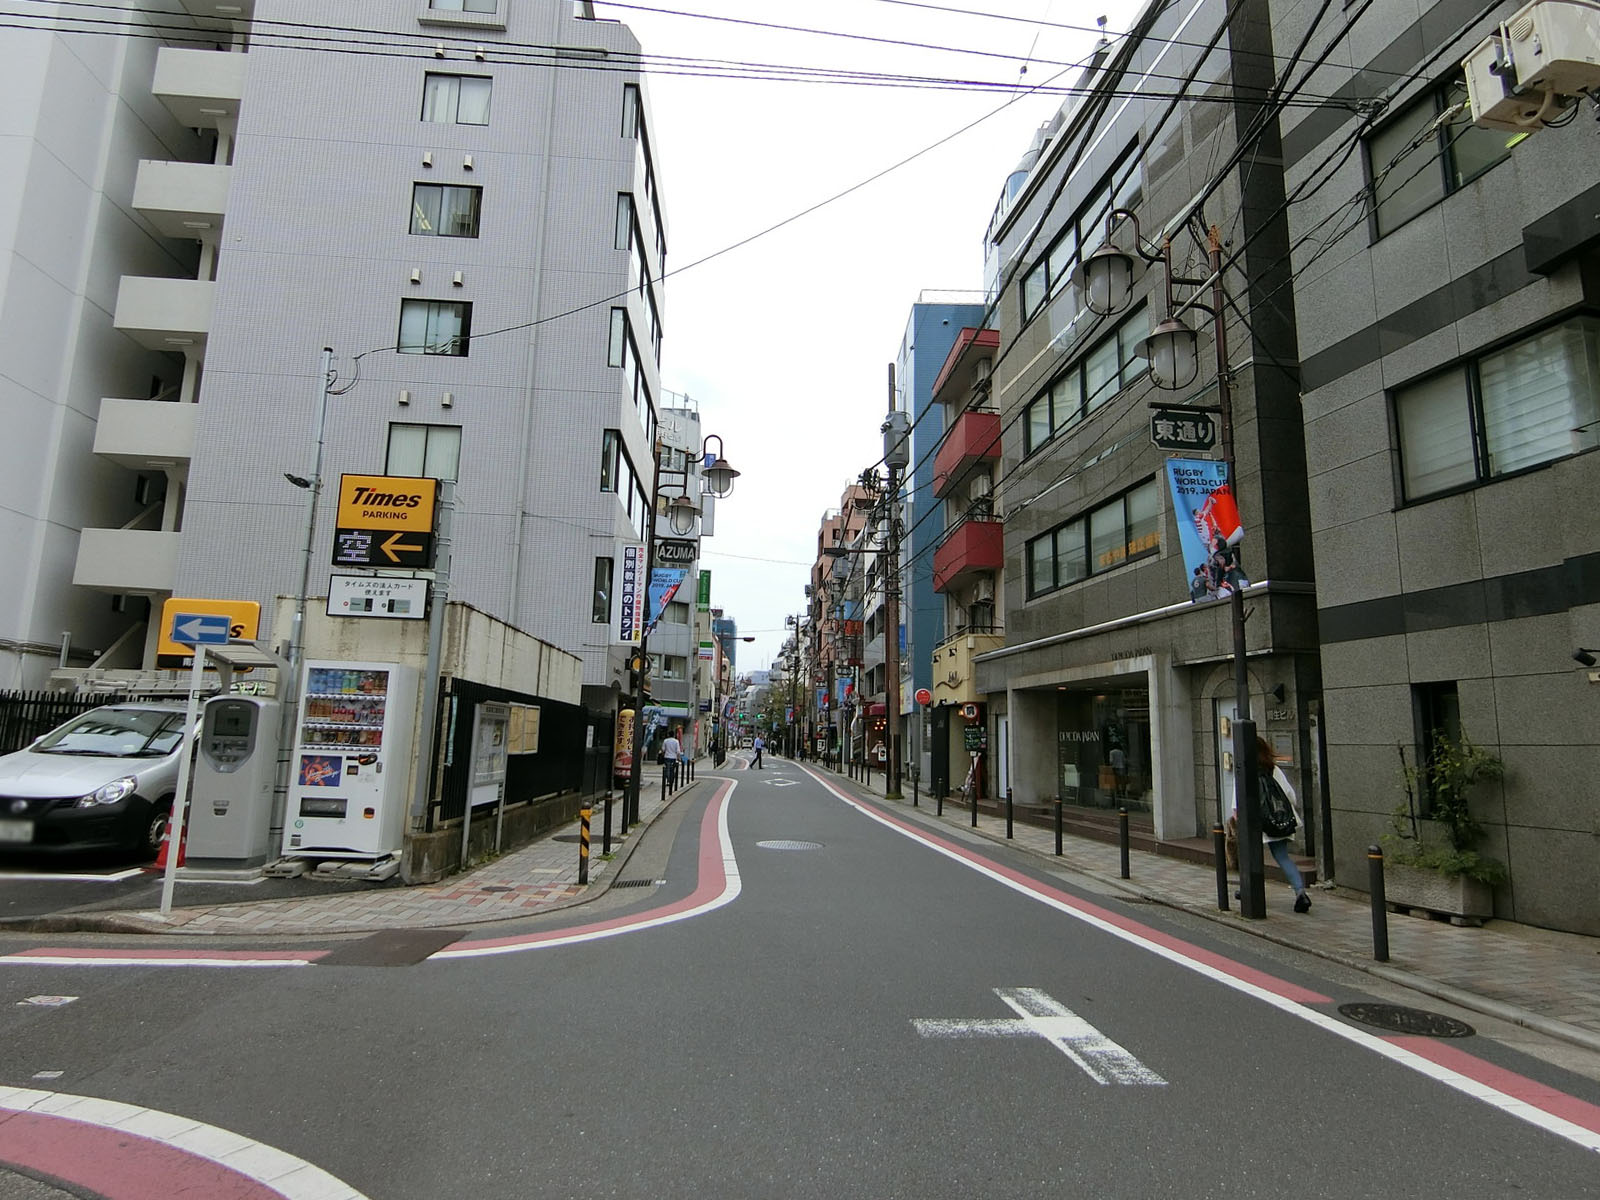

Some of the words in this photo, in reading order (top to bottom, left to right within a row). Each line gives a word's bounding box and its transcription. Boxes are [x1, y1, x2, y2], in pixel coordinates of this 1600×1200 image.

[1154, 420, 1213, 443] 東通り
[1173, 468, 1204, 477] RUGBY
[1174, 477, 1208, 486] WORLD
[1208, 479, 1229, 487] CUP
[1199, 487, 1231, 496] JAPAN
[351, 487, 422, 508] Times
[362, 510, 408, 520] PARKING
[337, 531, 372, 562] 空
[658, 545, 695, 559] AZUMA
[344, 581, 414, 590] タイムズの法人カード
[1193, 580, 1200, 588] 6
[364, 589, 392, 597] 使えます
[621, 547, 636, 640] 個別教室のトライ
[1081, 731, 1100, 743] JAPAN
